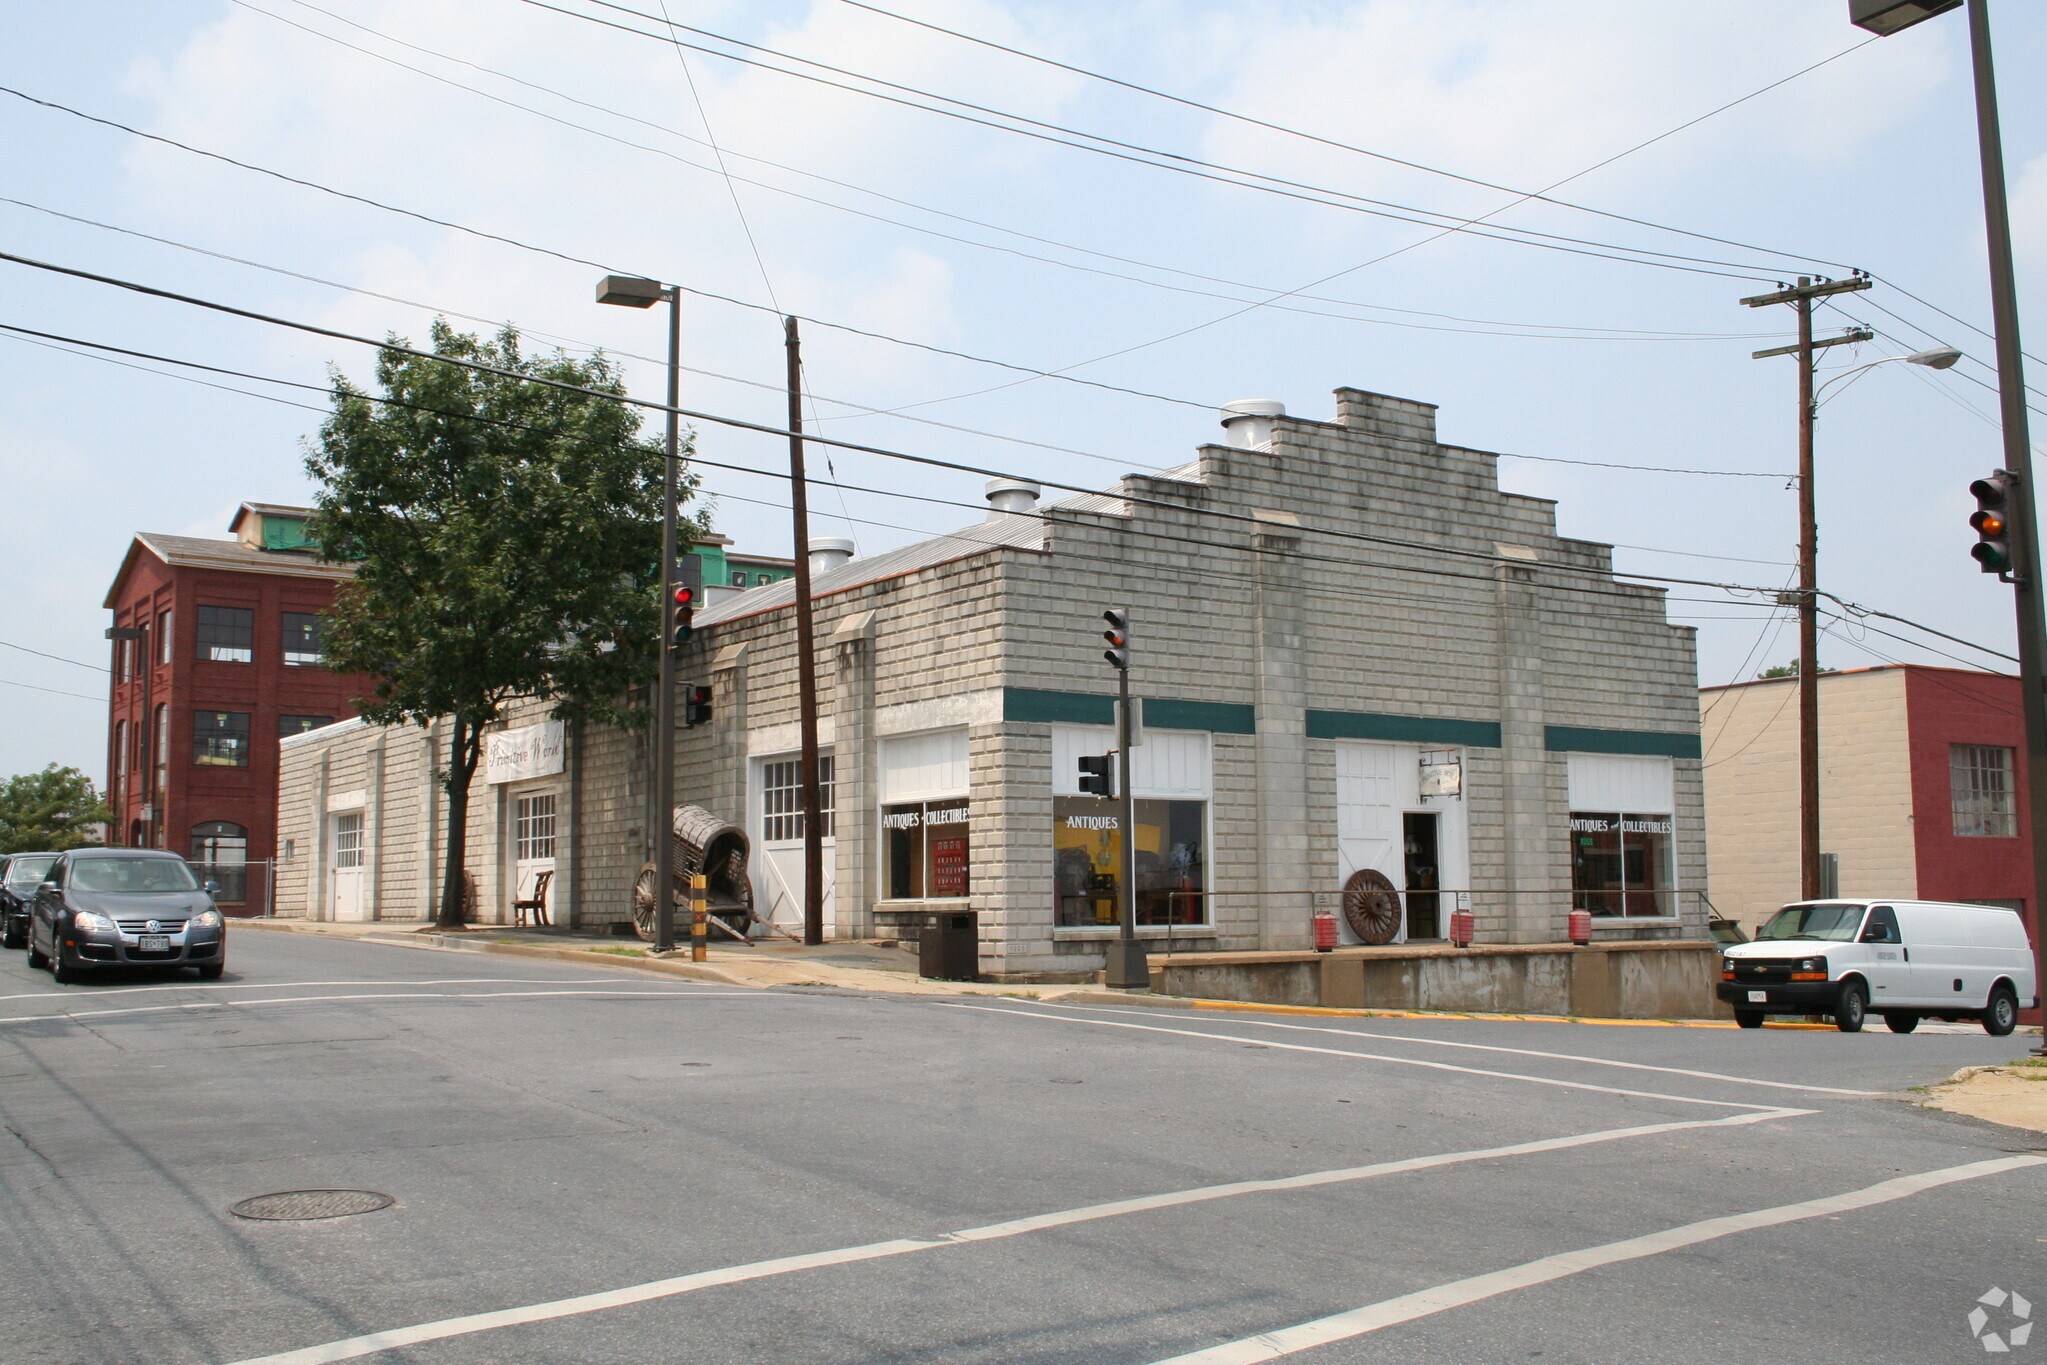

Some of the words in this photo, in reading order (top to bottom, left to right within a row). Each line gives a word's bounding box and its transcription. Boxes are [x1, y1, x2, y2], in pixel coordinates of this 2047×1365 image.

[489, 739, 528, 767] Primitive
[882, 812, 919, 830] ANTIQUES
[926, 808, 970, 825] COLLECTIBLES
[1066, 815, 1118, 831] ANTIQUES
[1569, 819, 1608, 832] ANTIQUES
[1622, 820, 1671, 834] COLLECTIBLES
